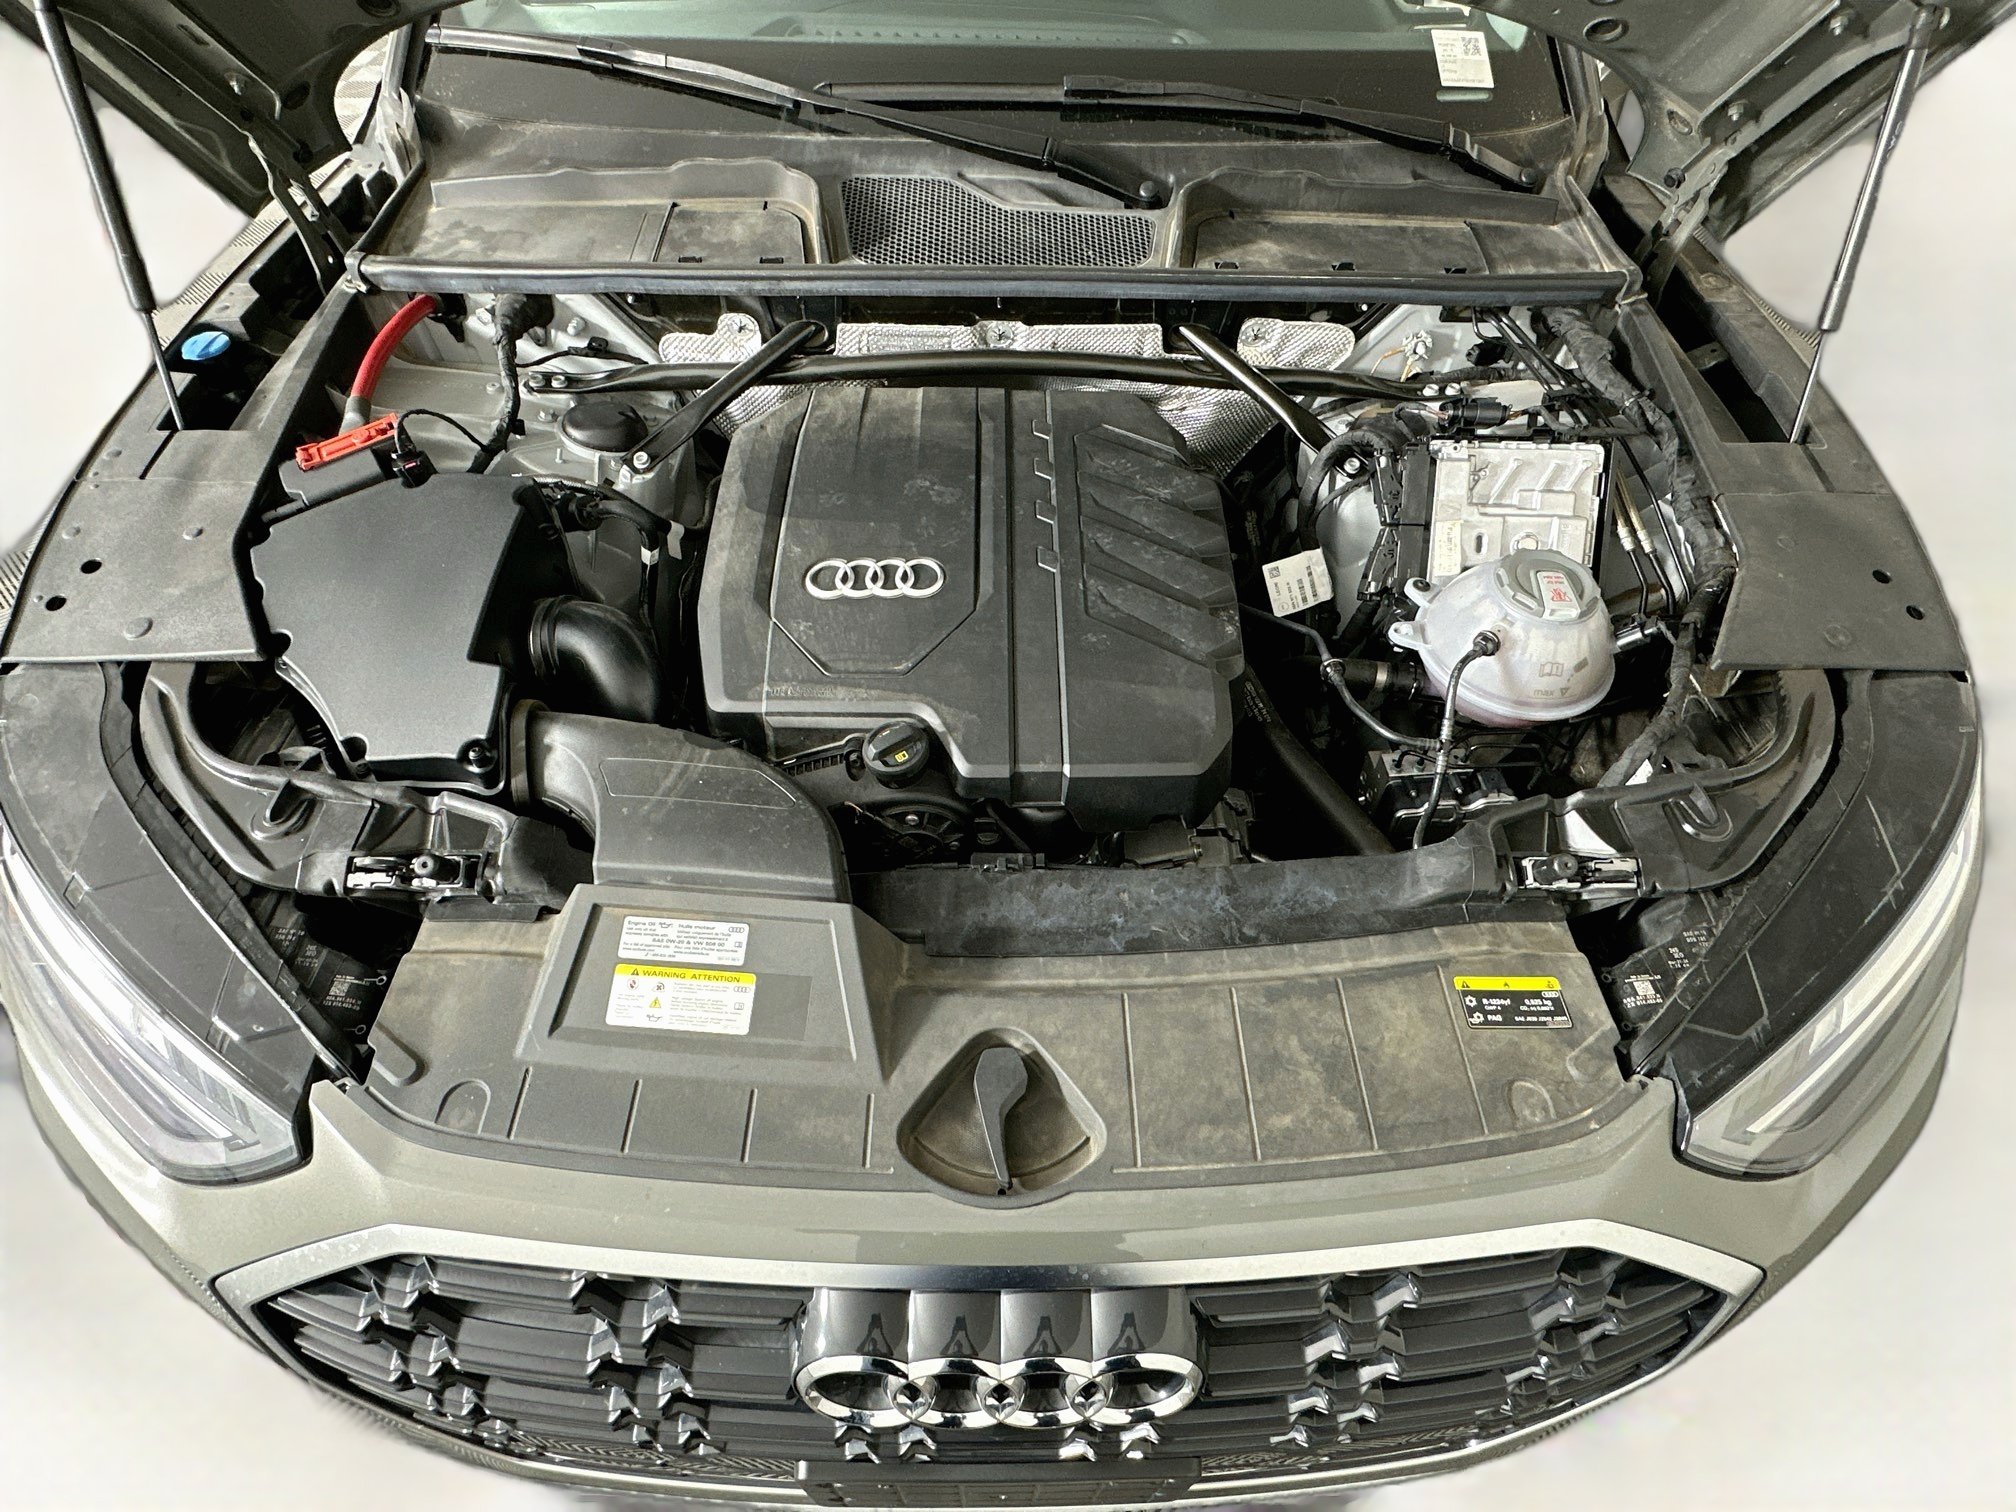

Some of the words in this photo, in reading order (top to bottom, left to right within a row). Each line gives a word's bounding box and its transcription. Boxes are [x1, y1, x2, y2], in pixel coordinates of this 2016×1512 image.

[1533, 689, 1555, 697] max
[642, 970, 686, 979] WARNING
[691, 973, 741, 983] ATTENTION
